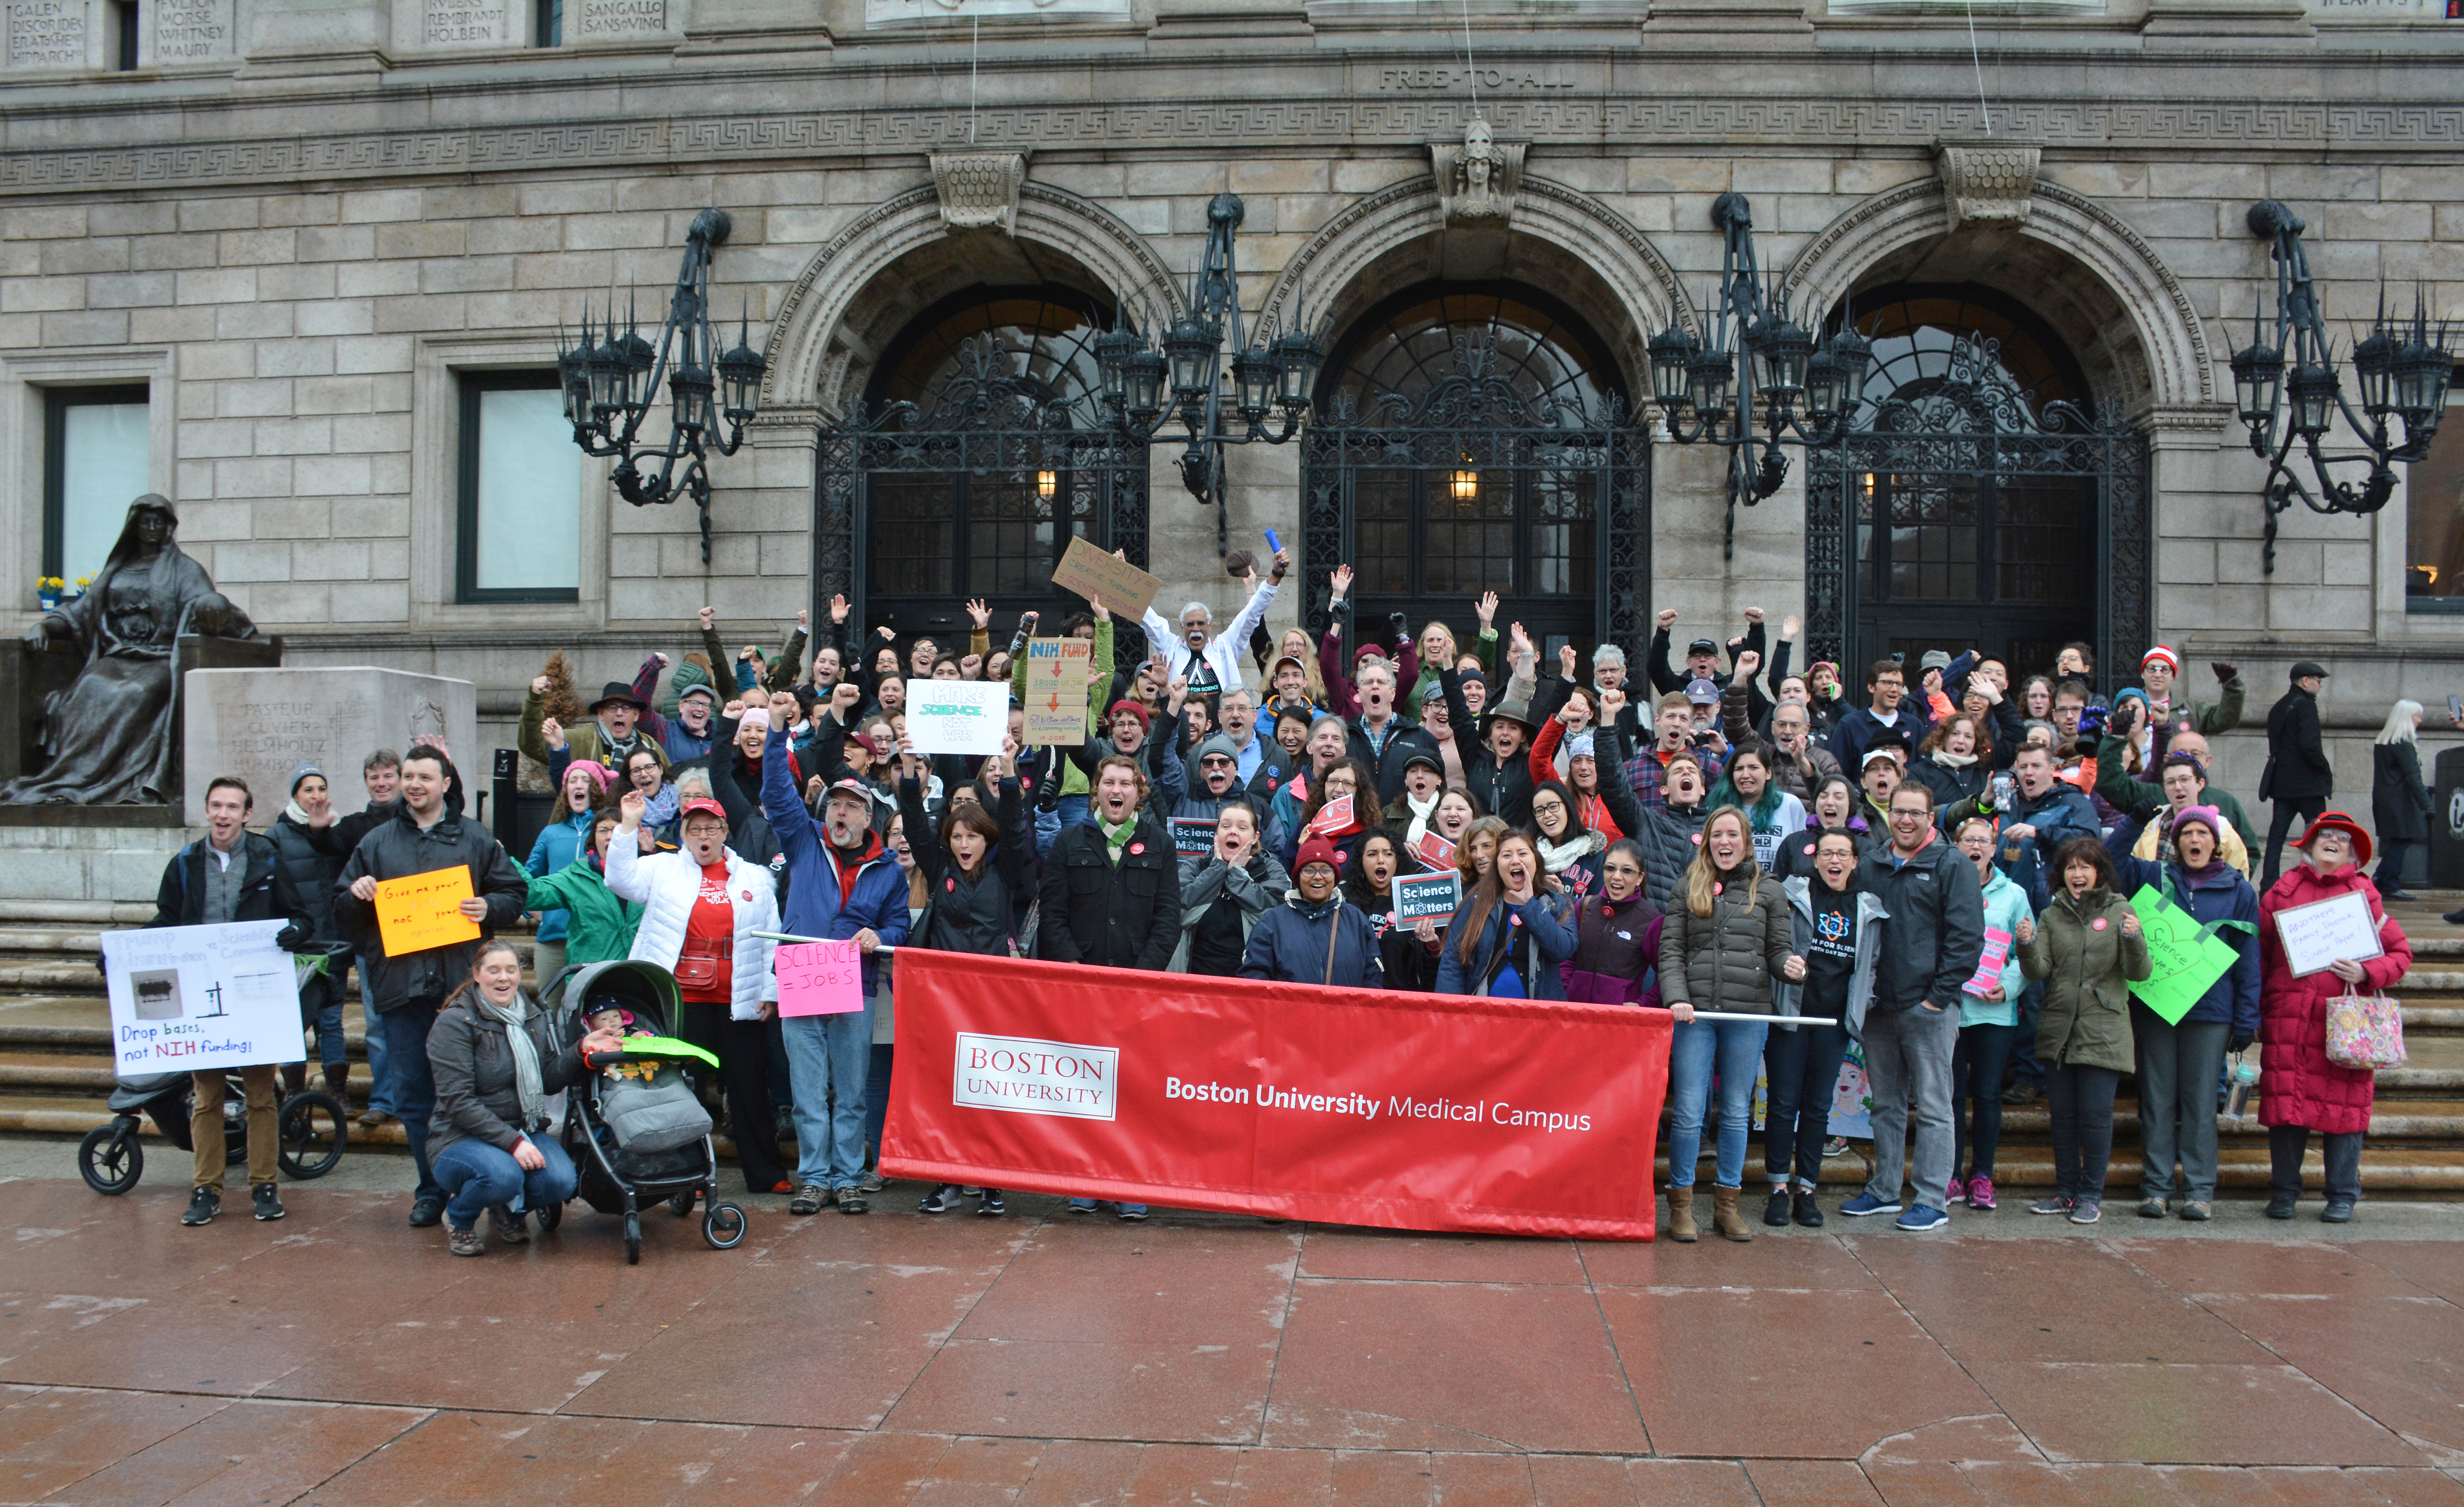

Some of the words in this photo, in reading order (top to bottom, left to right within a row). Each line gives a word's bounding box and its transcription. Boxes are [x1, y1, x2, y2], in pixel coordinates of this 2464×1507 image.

[15, 4, 62, 17] GALEN
[585, 2, 661, 17] SANGALLO
[161, 11, 211, 26] MORSE
[429, 10, 503, 26] REMBRANDT
[585, 18, 661, 33] SANSOVINO
[160, 26, 225, 40] WHITNEY
[429, 26, 491, 42] HOLBEIN
[161, 43, 212, 57] MAURY
[1071, 540, 1145, 584] DIVERSITY
[1068, 559, 1105, 582] CREATIVE
[1106, 595, 1141, 616] DISCOVERY
[1030, 642, 1059, 658] NIH
[1061, 643, 1089, 658] FUND
[933, 684, 987, 704] MAKE
[245, 703, 313, 716] PASTEUR
[248, 721, 312, 735] CUVIER
[942, 717, 972, 728] NOT
[943, 730, 972, 741] WAR
[232, 740, 326, 753] HELMHOLTZ
[234, 758, 324, 771] HUMBOT
[1177, 827, 1214, 838] Scienc
[435, 881, 459, 892] your
[1403, 886, 1452, 899] Science
[705, 896, 730, 904] WALK
[393, 915, 412, 924] not
[435, 909, 458, 920] your
[2288, 907, 2335, 934] ANOTHER
[220, 927, 274, 944] Scientific
[411, 927, 446, 938] opinion
[2292, 930, 2320, 946] FAMILY
[109, 931, 176, 950] Trump
[1819, 940, 1835, 949] FOR
[1836, 944, 1855, 953] SCIEN
[2147, 927, 2187, 966] Science
[780, 942, 859, 970] SCIENCE
[799, 969, 854, 989] JOBS
[122, 1025, 158, 1042] Drop
[164, 1023, 205, 1035] bases,
[125, 1047, 149, 1061] not
[156, 1040, 196, 1058] NIH
[201, 1039, 252, 1054] funding!
[968, 1047, 1104, 1081] BOSTON
[967, 1078, 1103, 1104] UNIVERSITY
[1166, 1077, 1249, 1104] Boston
[1256, 1084, 1381, 1121] University
[1388, 1095, 1484, 1122] Medical
[1492, 1102, 1591, 1133] Campus
